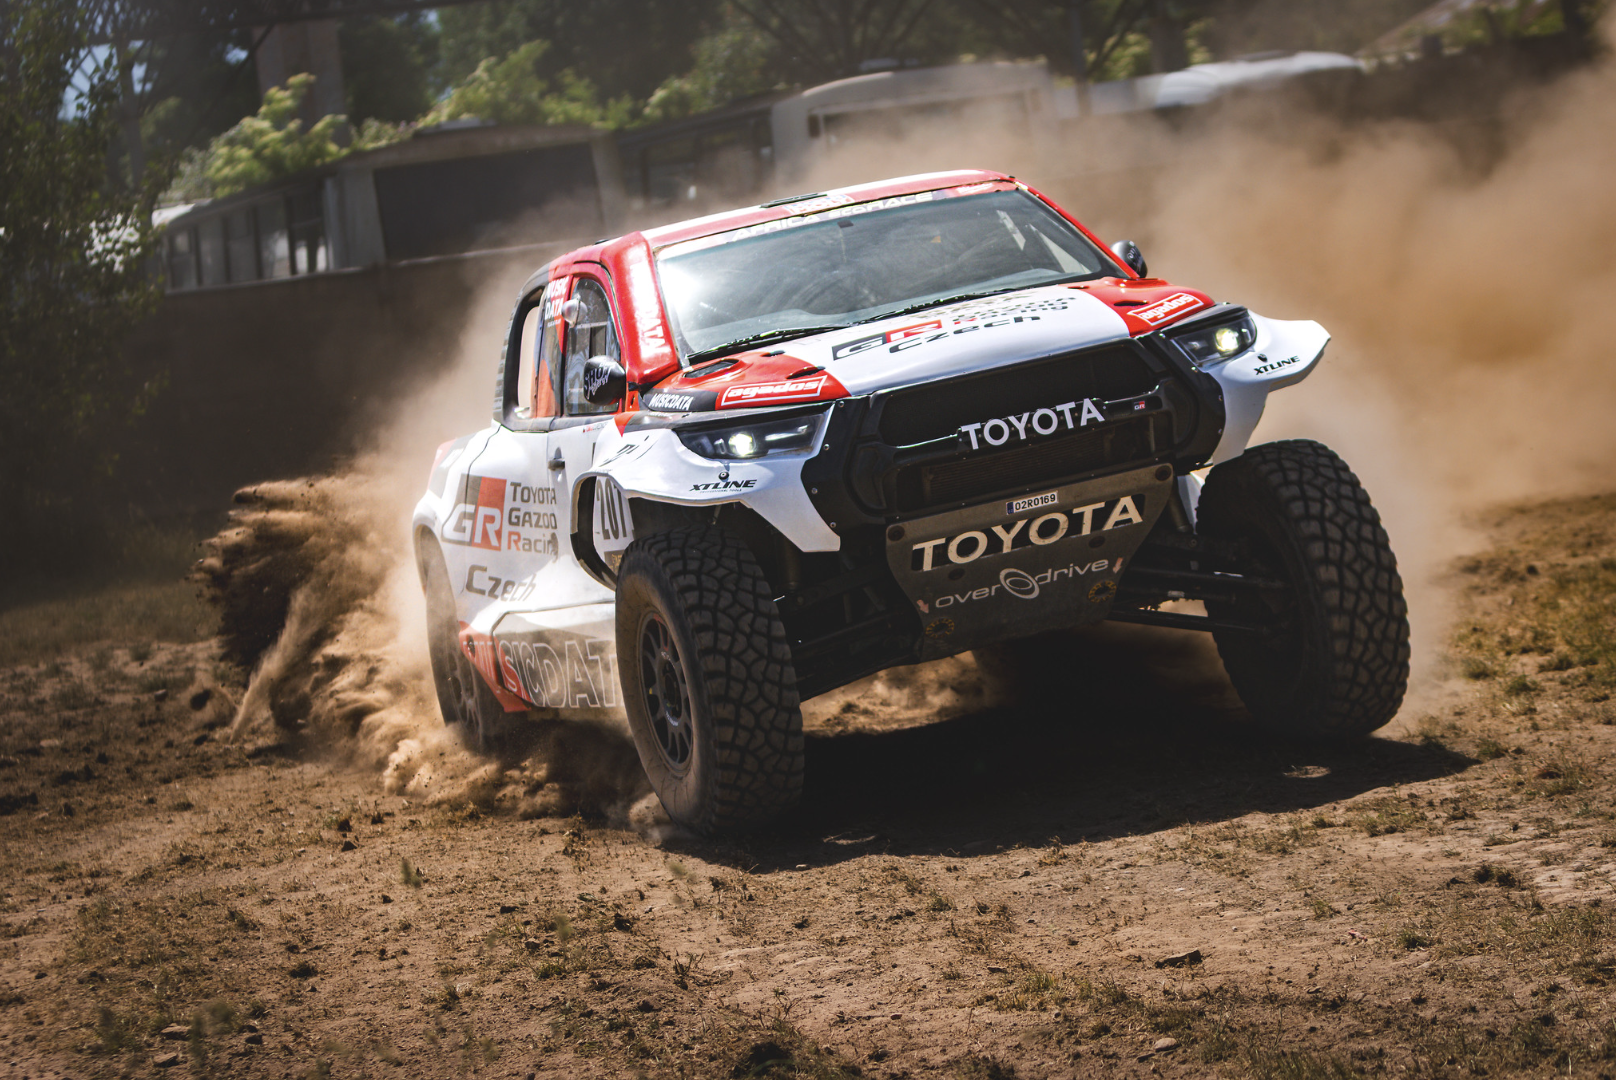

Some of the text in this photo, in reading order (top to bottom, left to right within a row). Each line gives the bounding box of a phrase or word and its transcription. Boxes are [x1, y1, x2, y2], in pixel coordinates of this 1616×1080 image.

[545, 298, 563, 320] DATA
[1139, 294, 1195, 319] agados
[1253, 355, 1301, 376] XTLINE
[728, 380, 820, 398] agados
[648, 393, 694, 411] MUSICDATA
[1134, 401, 1145, 410] GR
[961, 397, 1105, 450] TOYOTA
[689, 479, 757, 492] XTLINE
[442, 503, 502, 547] GR
[912, 495, 1143, 572] TOYOTA
